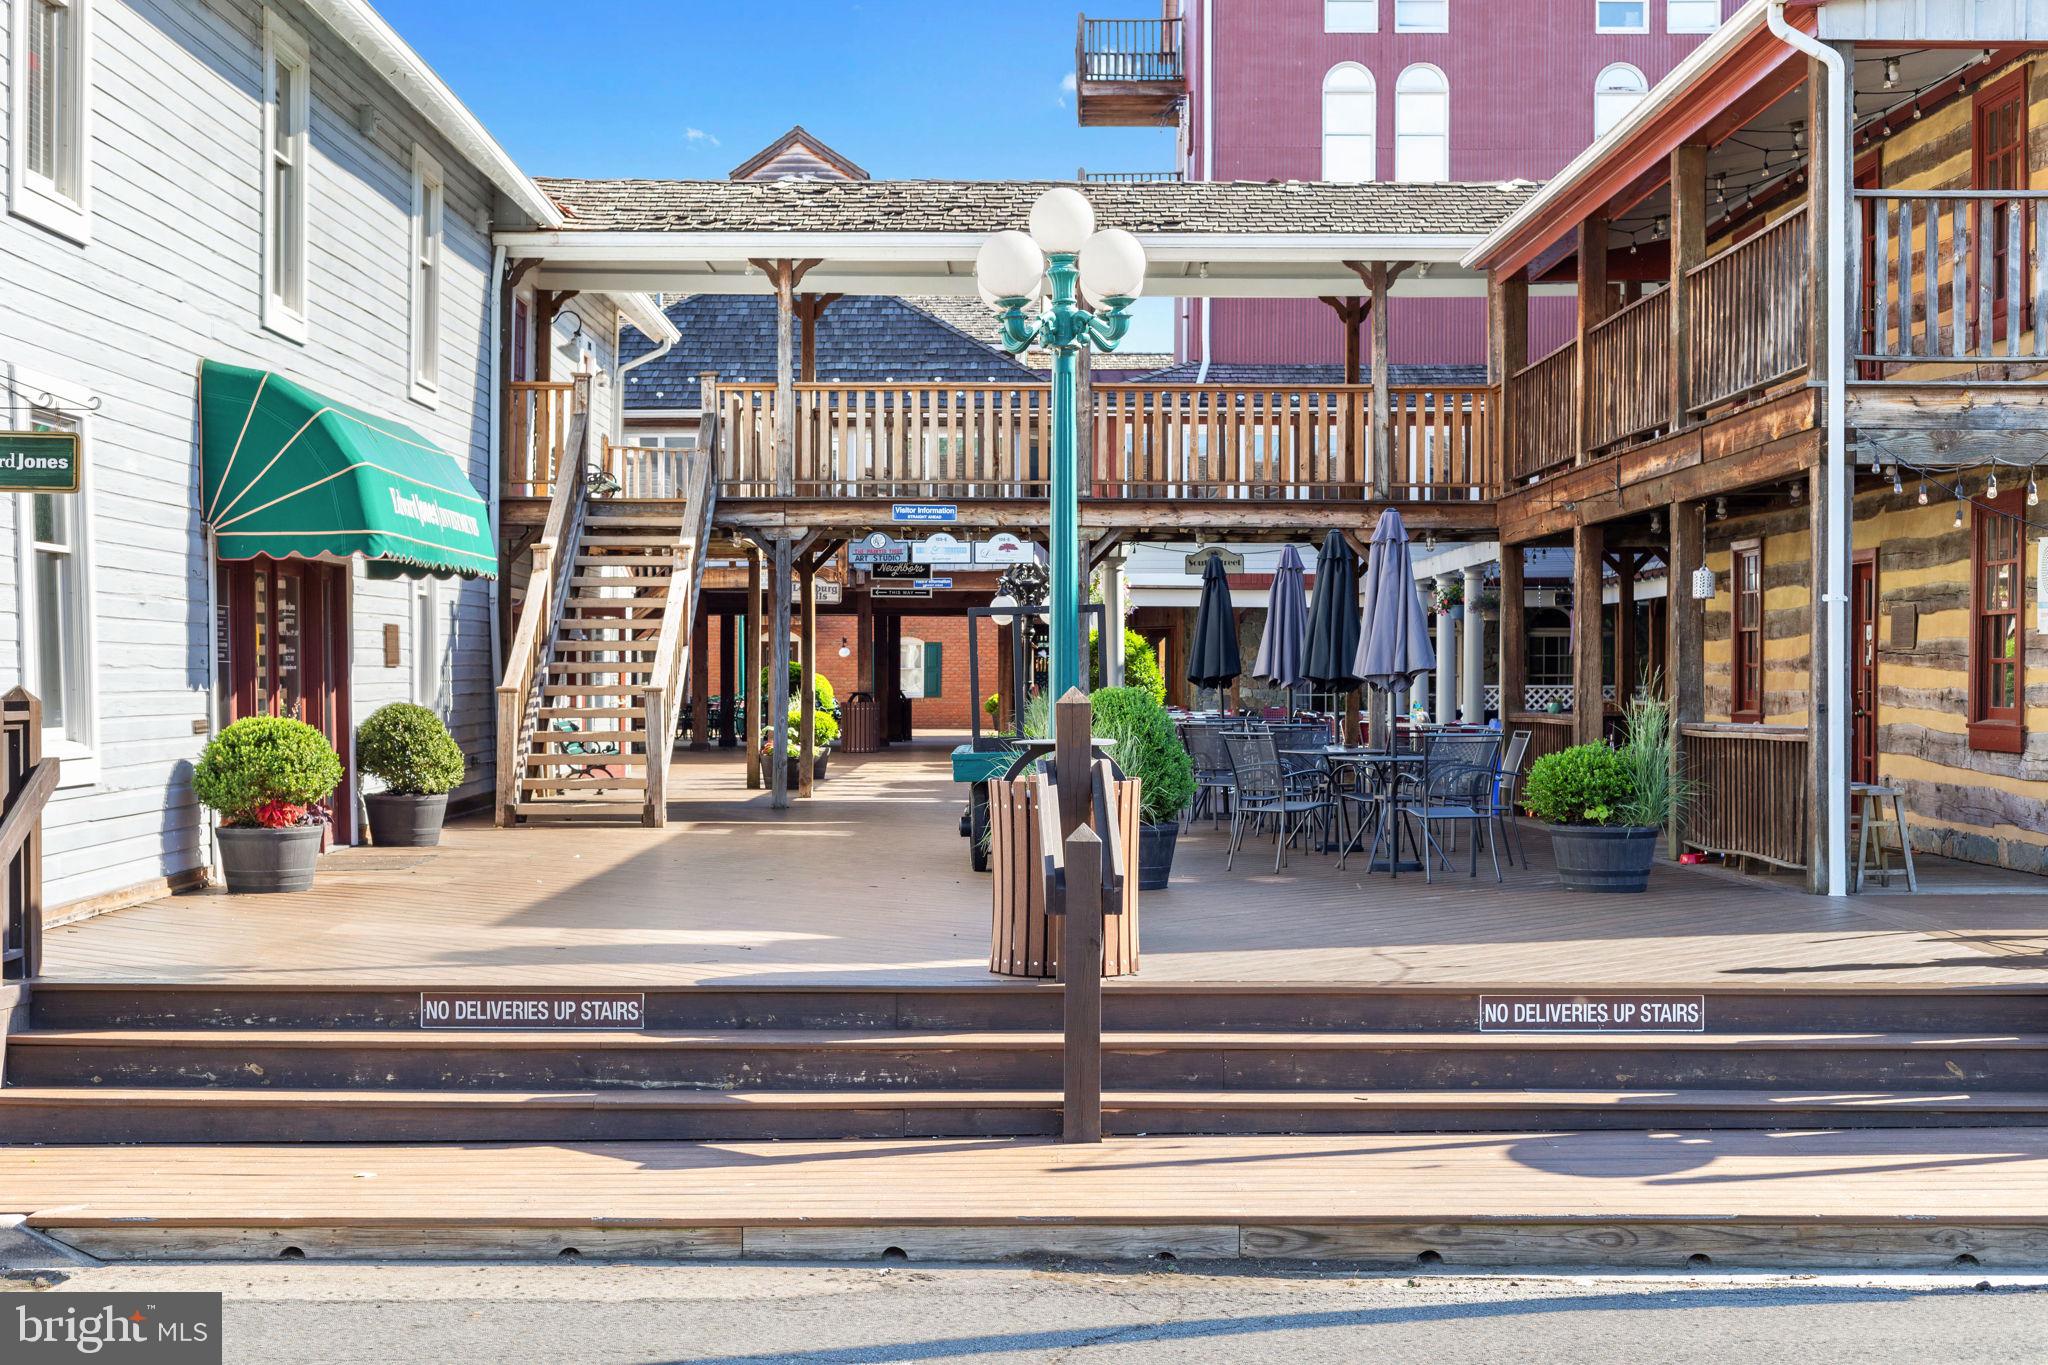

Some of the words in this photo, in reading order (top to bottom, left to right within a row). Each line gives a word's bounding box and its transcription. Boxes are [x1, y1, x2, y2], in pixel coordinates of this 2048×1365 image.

[895, 506, 916, 514] Visitor
[917, 506, 955, 514] Information
[877, 562, 926, 576] Neighbors
[426, 1001, 450, 1020] NO
[455, 1001, 549, 1020] DELIVERIES
[554, 1001, 576, 1020] UP
[581, 1001, 639, 1020] STAIRS
[1485, 1003, 1508, 1022] NO
[1514, 1003, 1608, 1023] DELIVERIES
[1614, 1003, 1635, 1022] UP
[1640, 1003, 1699, 1023] STAIRS
